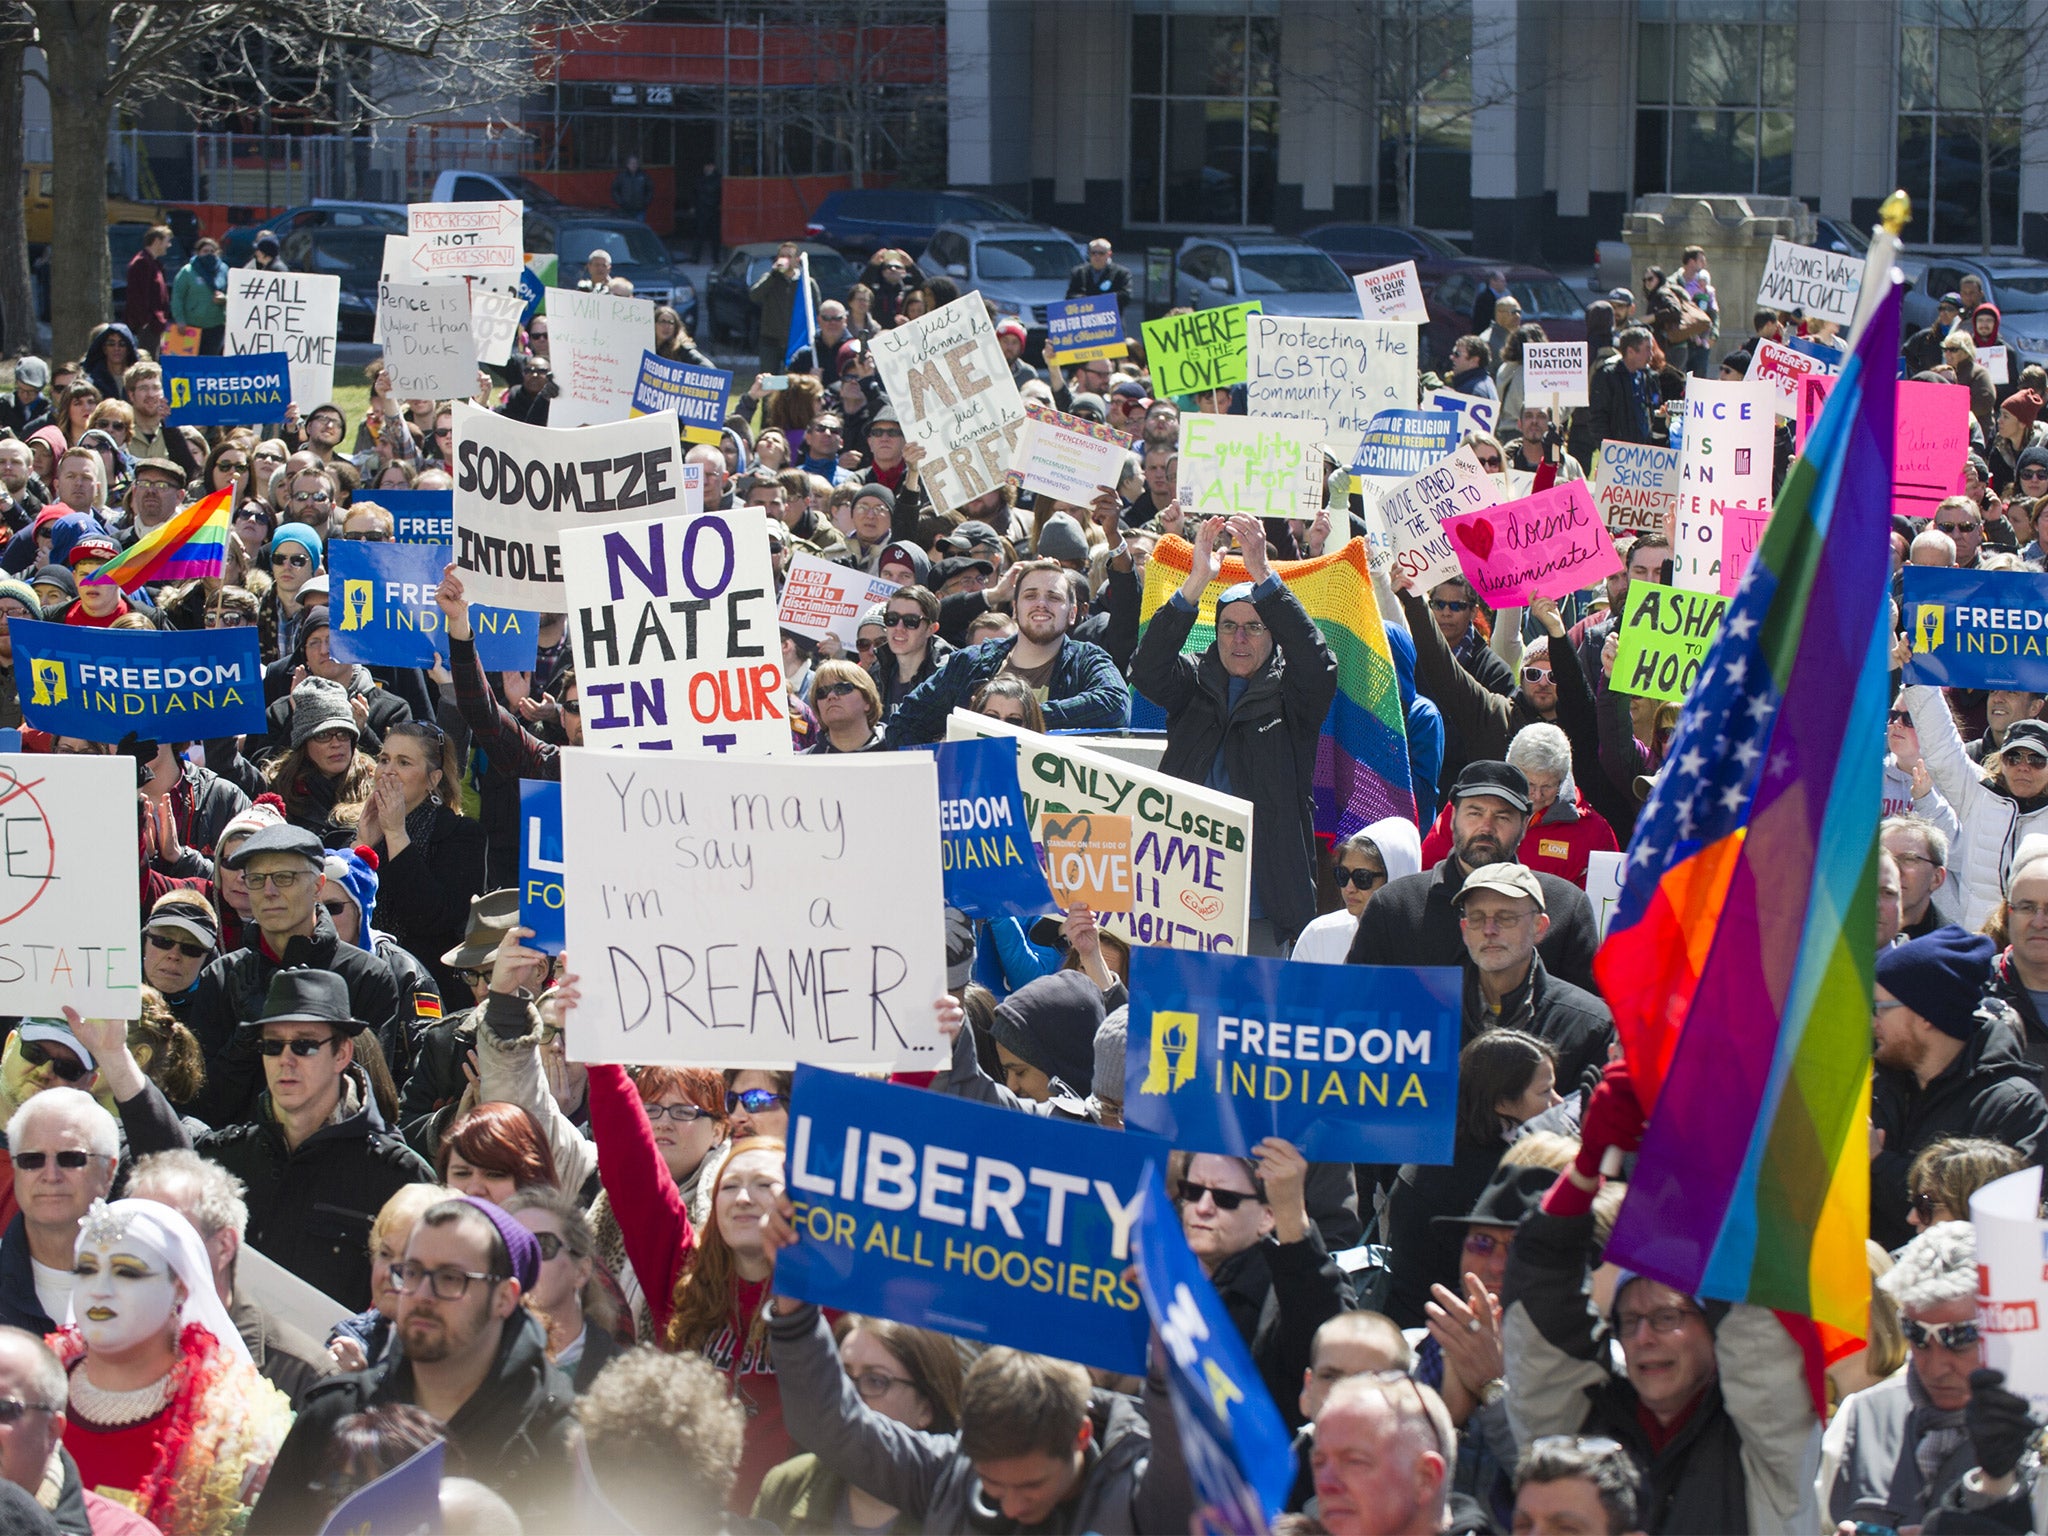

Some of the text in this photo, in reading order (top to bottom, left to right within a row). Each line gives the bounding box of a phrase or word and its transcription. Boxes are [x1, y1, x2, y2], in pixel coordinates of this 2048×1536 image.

[415, 214, 500, 228] PROGRESSION
[437, 233, 478, 246] NOT
[431, 250, 512, 265] REGRESSION!
[1774, 245, 1855, 285] WRONG WAY
[239, 277, 307, 303] #ALL
[1364, 269, 1406, 287] NO HATE
[1370, 279, 1405, 295] IN OUR
[381, 285, 430, 312] Pence
[441, 294, 457, 312] is
[571, 294, 600, 319] Will
[1375, 289, 1405, 303] STATE!
[245, 305, 305, 333] ARE
[429, 317, 469, 334] than
[917, 307, 961, 349] just
[1050, 311, 1117, 333] OPEN FOR BUSINESS
[1150, 307, 1246, 354] WHERE
[384, 337, 392, 355] A
[404, 335, 459, 356] Duck
[912, 317, 992, 365] wanna be
[1186, 342, 1235, 361] IS THE
[1260, 318, 1408, 374] Protecting the
[1529, 347, 1582, 358] DISCRIM
[1257, 355, 1347, 380] LGBTQ
[1529, 359, 1582, 369] INATION
[1765, 347, 1810, 372] WHERE'S
[1776, 365, 1790, 374] THE
[196, 374, 280, 391] FREEDOM
[386, 363, 440, 391] Penis
[643, 358, 726, 390] FREEDOM OF RELIGION
[907, 339, 993, 422] ME
[1159, 353, 1237, 395] LOVE
[1759, 367, 1799, 391] LOVE?
[198, 390, 282, 406] INDIANA
[637, 383, 720, 422] DISCRIMINATE
[710, 391, 719, 401] TO
[1249, 381, 1400, 410] Community is a
[950, 408, 1021, 450] wanna be
[953, 400, 984, 434] just
[1391, 418, 1451, 435] OF RELIGION
[1055, 432, 1108, 454] #PENCEMUSTGO
[1184, 419, 1301, 468] Equality
[1382, 434, 1446, 449] MEAN FREEDOM TO
[1687, 435, 1712, 455] IS
[1032, 455, 1076, 474] #PENCEMUSTGO
[1455, 458, 1478, 474] SHAME!
[1604, 444, 1679, 471] COMMON
[459, 440, 676, 512] SODOMIZE
[1027, 473, 1071, 491] #PENCEMUSTGO
[1050, 471, 1094, 489] #PENCEMUSTGO
[1246, 459, 1296, 489] For
[1303, 442, 1324, 508] #EFA
[1415, 467, 1455, 505] OPENED
[1613, 465, 1664, 487] SENSE
[1683, 463, 1714, 483] AN
[1200, 478, 1296, 517] ALL!
[1600, 485, 1677, 508] AGAINST
[1404, 485, 1481, 539] THE DOOR TO
[1608, 504, 1664, 529] PENCE
[1681, 523, 1713, 542] TO
[603, 515, 734, 601] NO
[1398, 549, 1429, 578] SO
[1478, 528, 1604, 593] discriminate!
[789, 586, 835, 600] say NO to
[781, 610, 829, 627] in Indiana
[784, 596, 855, 617] discrimination
[1956, 607, 2048, 631] FREED
[385, 609, 521, 635] INDINA
[579, 589, 764, 668] HATE
[1685, 643, 1702, 656] TO
[1956, 632, 2048, 656] INDIA
[80, 663, 241, 689] FREEDOM
[82, 687, 243, 714] INDIANA
[587, 678, 667, 729] IN
[689, 664, 783, 725] OUR
[1032, 752, 1136, 813] ONLY
[1137, 787, 1246, 853] CLOSED
[607, 772, 846, 860] You may
[1047, 840, 1076, 848] STANDING
[1548, 845, 1567, 855] LOVE
[675, 836, 753, 890] say
[1048, 852, 1129, 892] LOVE
[1135, 830, 1225, 893] AME
[602, 883, 844, 930] I'm a
[0, 943, 138, 991] STATE
[608, 944, 934, 1051] DREAMER...
[1217, 1016, 1431, 1065] FREEDOM
[1216, 1060, 1429, 1107] INDIANA
[792, 1115, 1145, 1260] LIBERTY
[793, 1203, 1141, 1311] FOR ALL HOOSIERS
